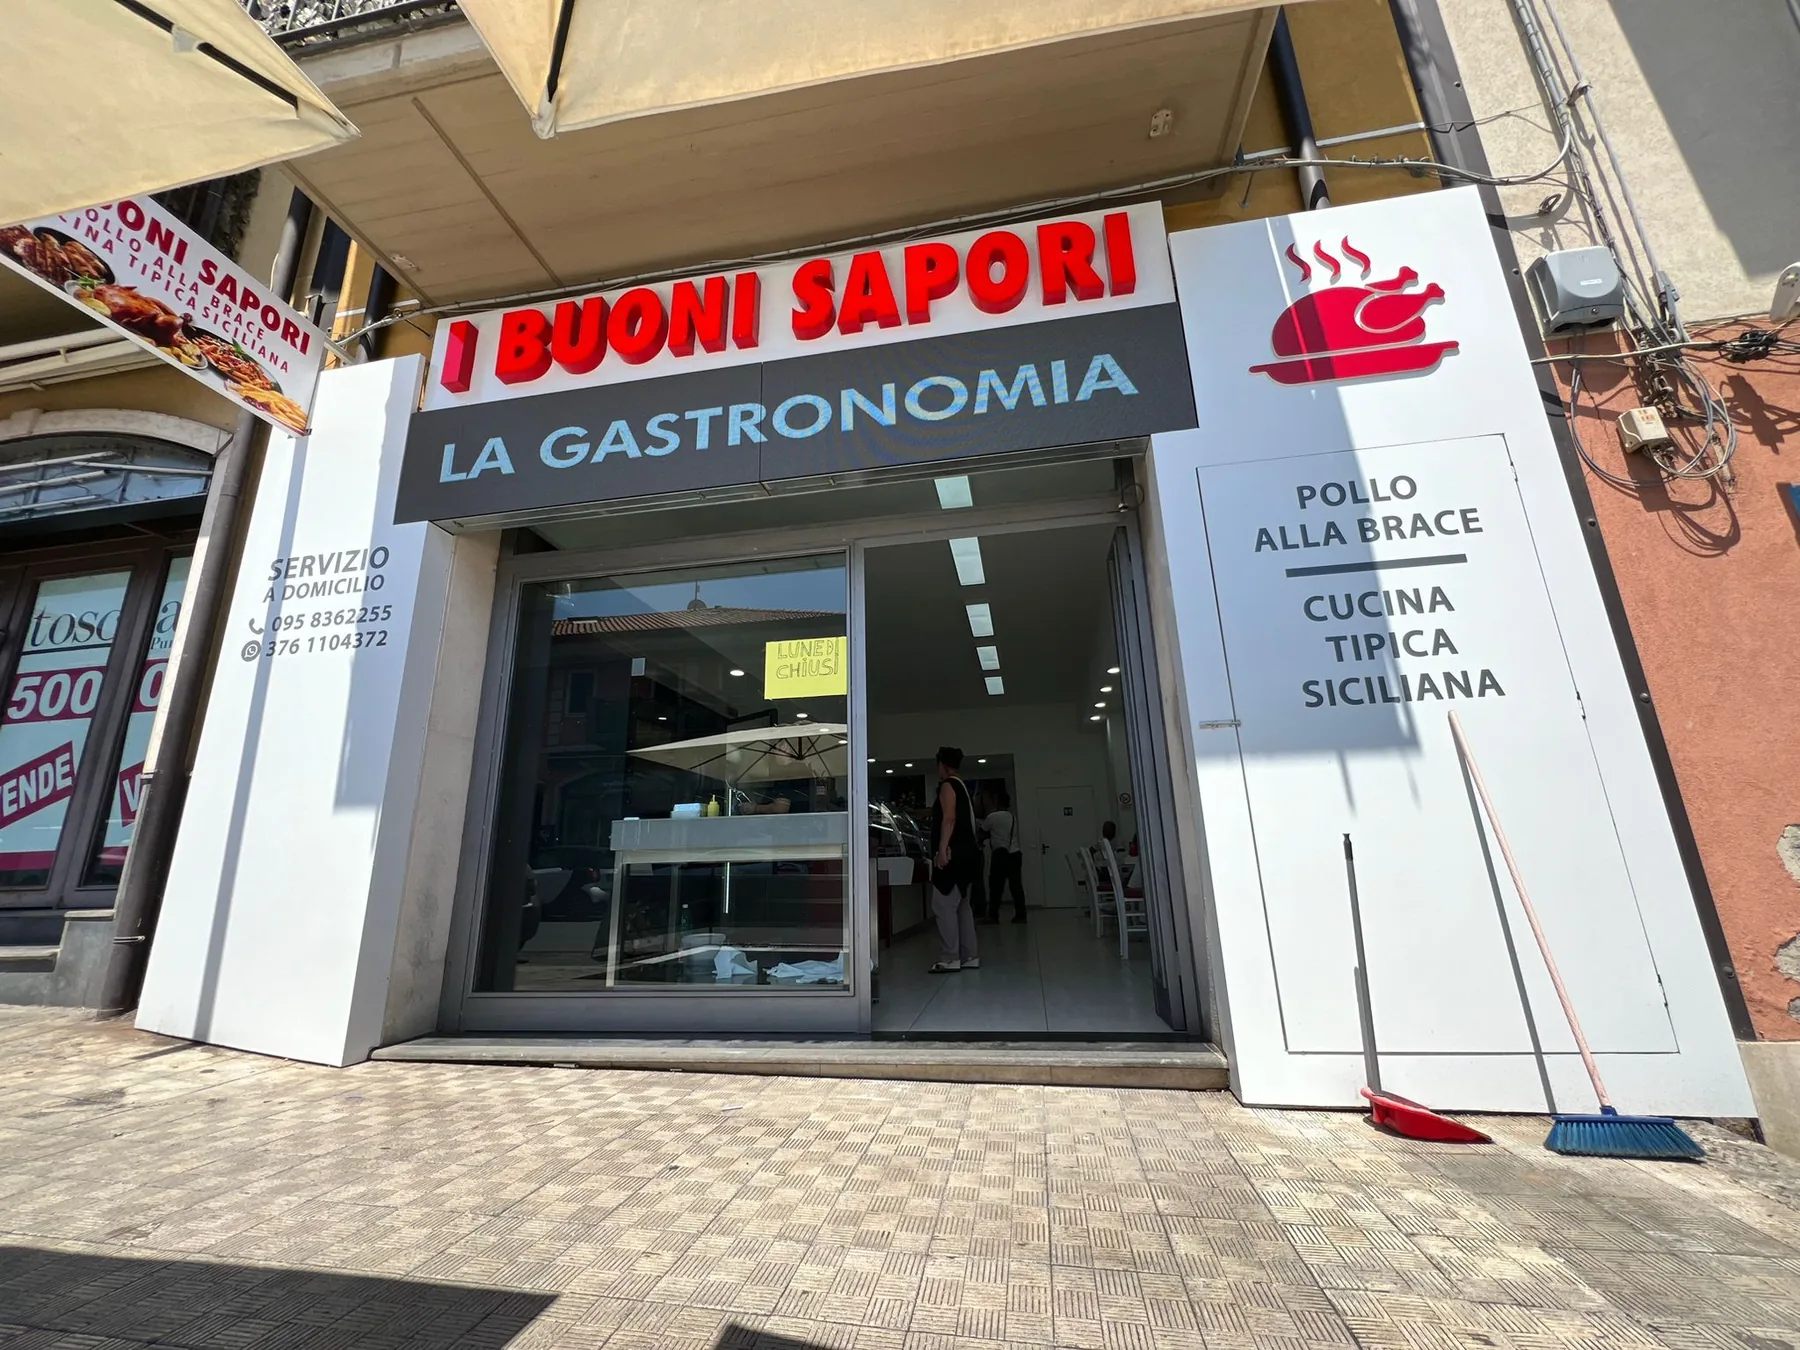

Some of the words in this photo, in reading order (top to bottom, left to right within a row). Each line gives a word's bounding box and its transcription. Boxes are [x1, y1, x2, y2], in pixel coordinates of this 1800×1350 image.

[58, 215, 114, 254] INA
[129, 253, 196, 310] TIPICA
[202, 307, 288, 373] SICILIANA
[100, 199, 188, 266] ONI
[198, 259, 310, 355] SAPORI
[153, 256, 199, 295] ALLA
[210, 295, 265, 341] BRACE
[440, 319, 478, 393] I
[495, 271, 760, 385] BUONI
[791, 211, 1136, 341] SAPORI
[439, 436, 515, 483] LA
[539, 352, 1140, 469] GASTRONOMIA
[1296, 475, 1418, 509] POLLO
[1254, 521, 1347, 552] ALLA
[1357, 507, 1484, 543] BRACE
[267, 546, 390, 581] SERVIZIO
[263, 586, 275, 603] A
[281, 574, 385, 601] DOMICILIO
[1303, 585, 1455, 622] CUCINA
[271, 614, 306, 632] 095
[310, 605, 393, 628] 8362255
[266, 638, 300, 657] 376
[307, 630, 388, 653] 1104372
[1325, 628, 1459, 662] TIPICA
[7, 670, 103, 720] 500
[1302, 668, 1506, 707] SICILIANA
[0, 752, 73, 817] ENDE
